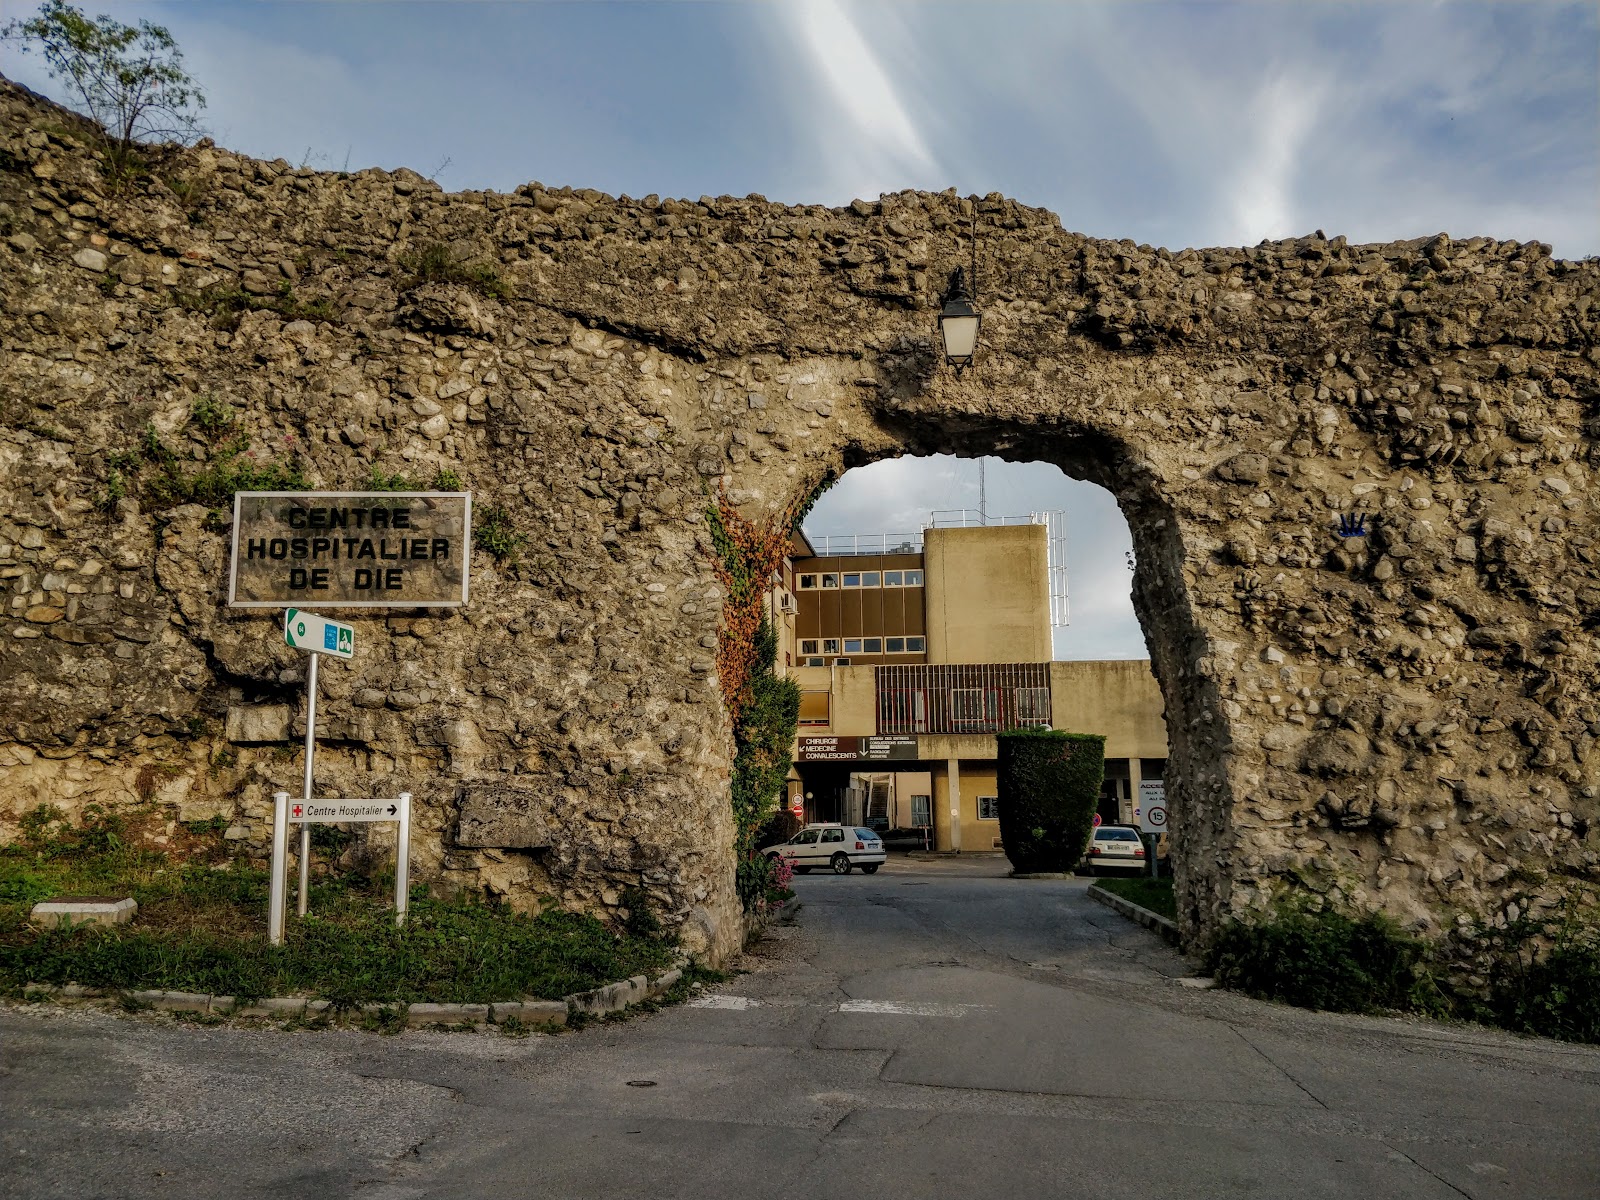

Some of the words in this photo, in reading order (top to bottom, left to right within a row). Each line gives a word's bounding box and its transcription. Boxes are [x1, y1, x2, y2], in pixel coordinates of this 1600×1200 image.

[288, 507, 411, 529] CENTRE
[247, 538, 450, 560] HOSPITALIER
[290, 568, 329, 590] DE
[354, 568, 403, 590] DIE
[307, 805, 336, 816] Centre
[338, 805, 383, 818] Hospitalier
[1152, 812, 1163, 821] 15
